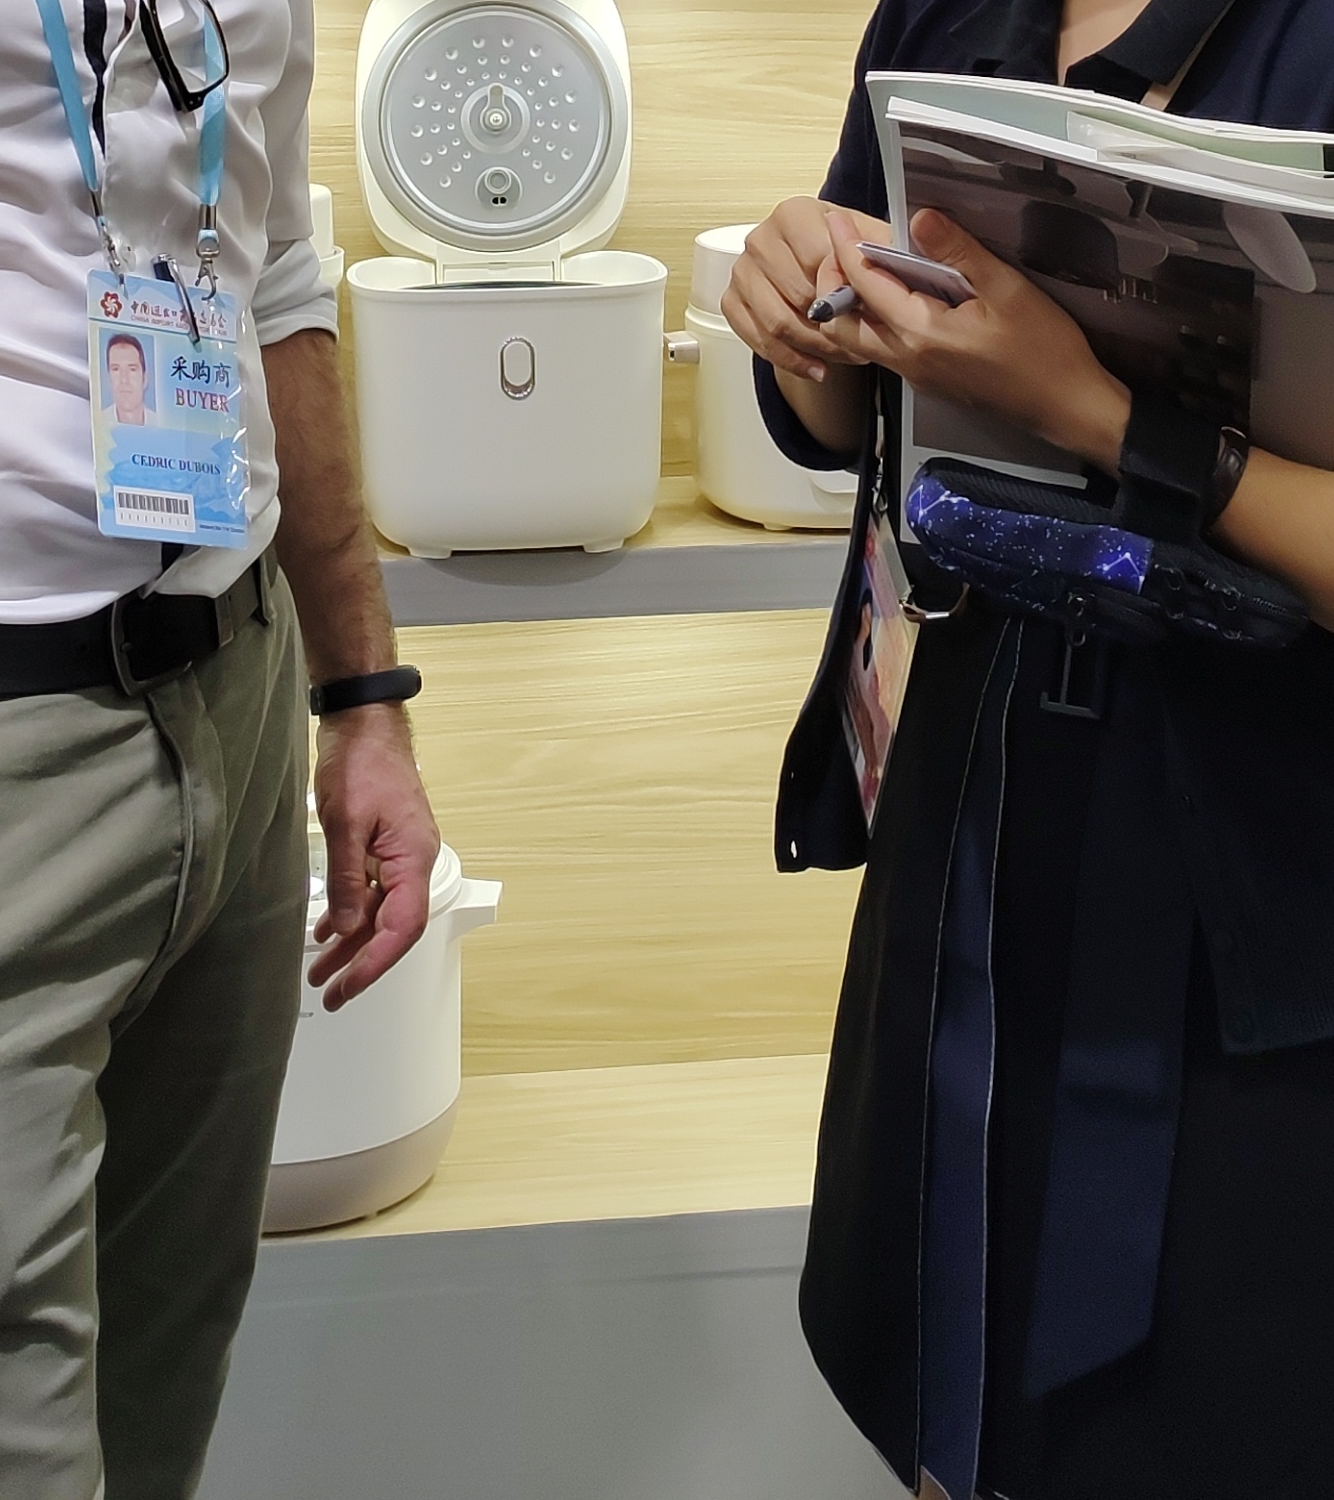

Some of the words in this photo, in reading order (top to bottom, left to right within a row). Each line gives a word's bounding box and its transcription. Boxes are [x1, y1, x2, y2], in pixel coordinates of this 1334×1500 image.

[171, 356, 232, 387] 采购商
[176, 389, 229, 412] BUYER
[132, 453, 175, 470] CEDRIC
[179, 460, 220, 474] DUBOIS
